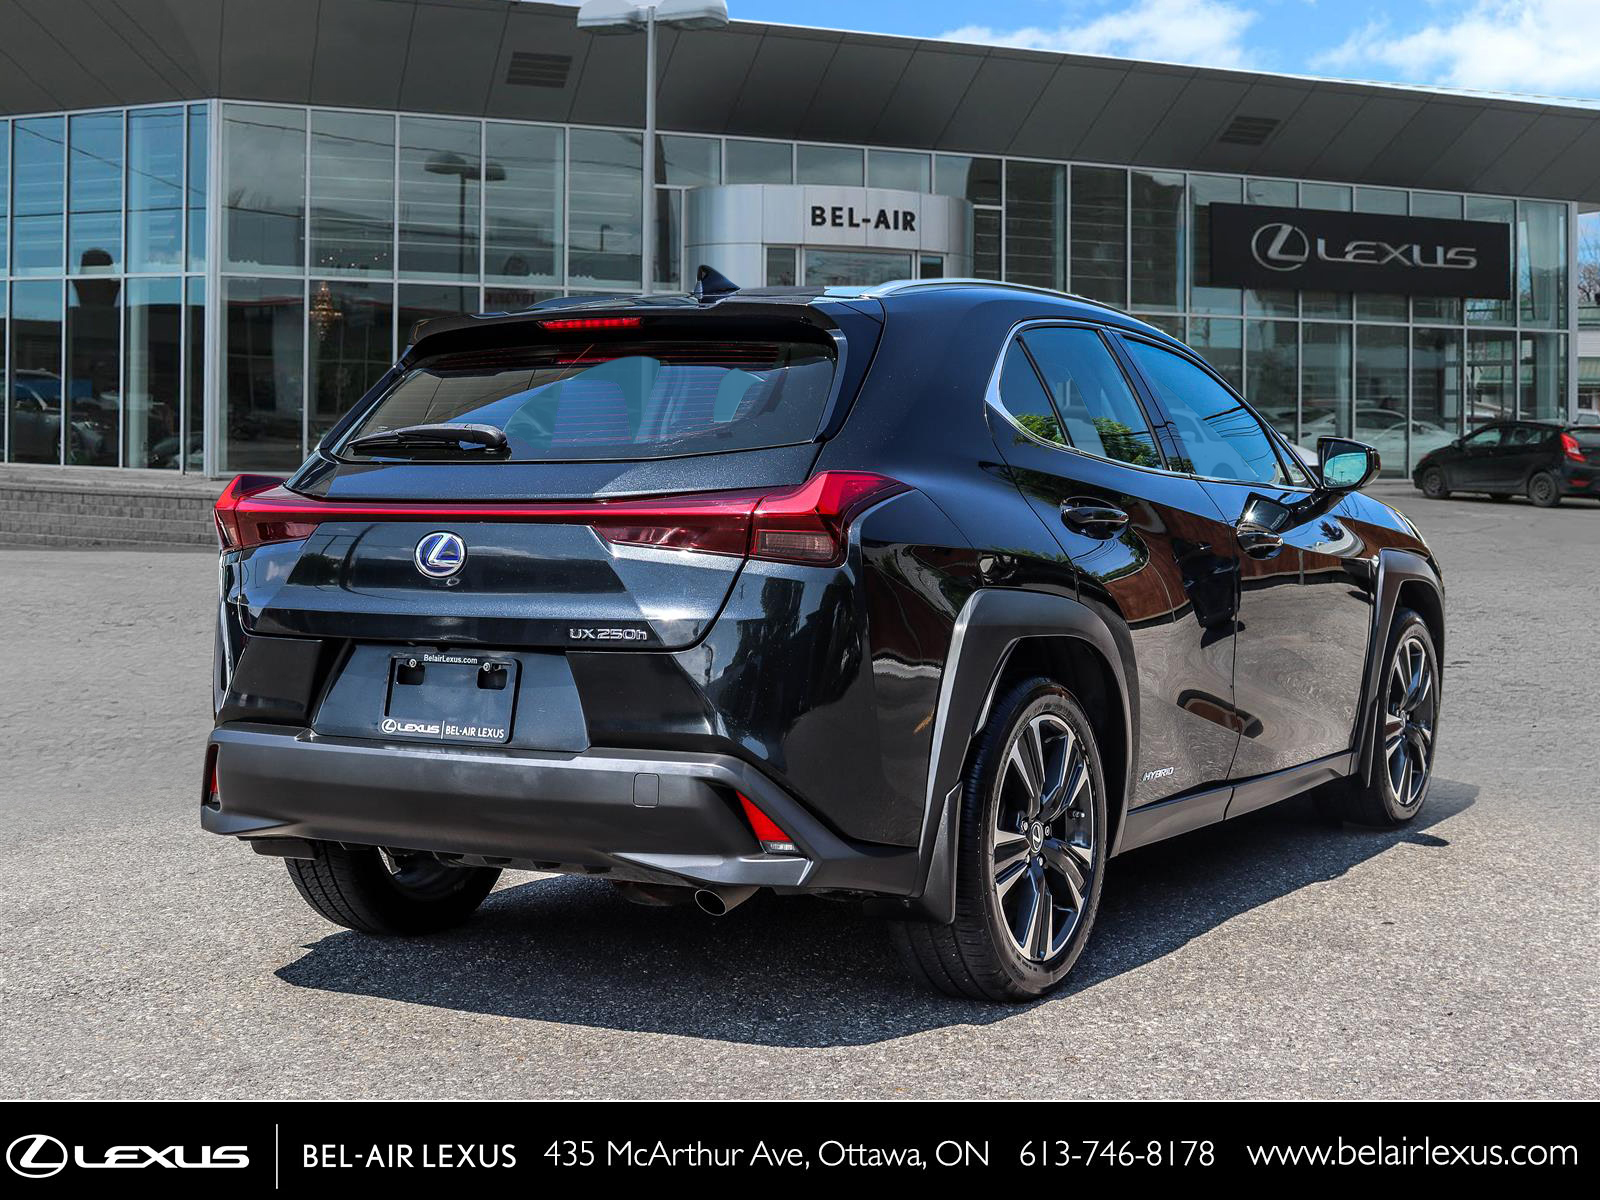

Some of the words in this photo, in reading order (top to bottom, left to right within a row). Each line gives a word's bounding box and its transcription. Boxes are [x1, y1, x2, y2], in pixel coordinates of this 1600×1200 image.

[811, 206, 916, 232] BEL-AIR
[1316, 237, 1478, 269] LEXUS
[569, 628, 595, 639] UX
[597, 628, 647, 640] 250h
[423, 654, 478, 664] BelairLexus.com
[397, 722, 440, 734] LEXUS
[445, 726, 476, 737] BEL-AIR
[477, 728, 505, 738] LEXUS
[1142, 766, 1174, 782] HYBRID
